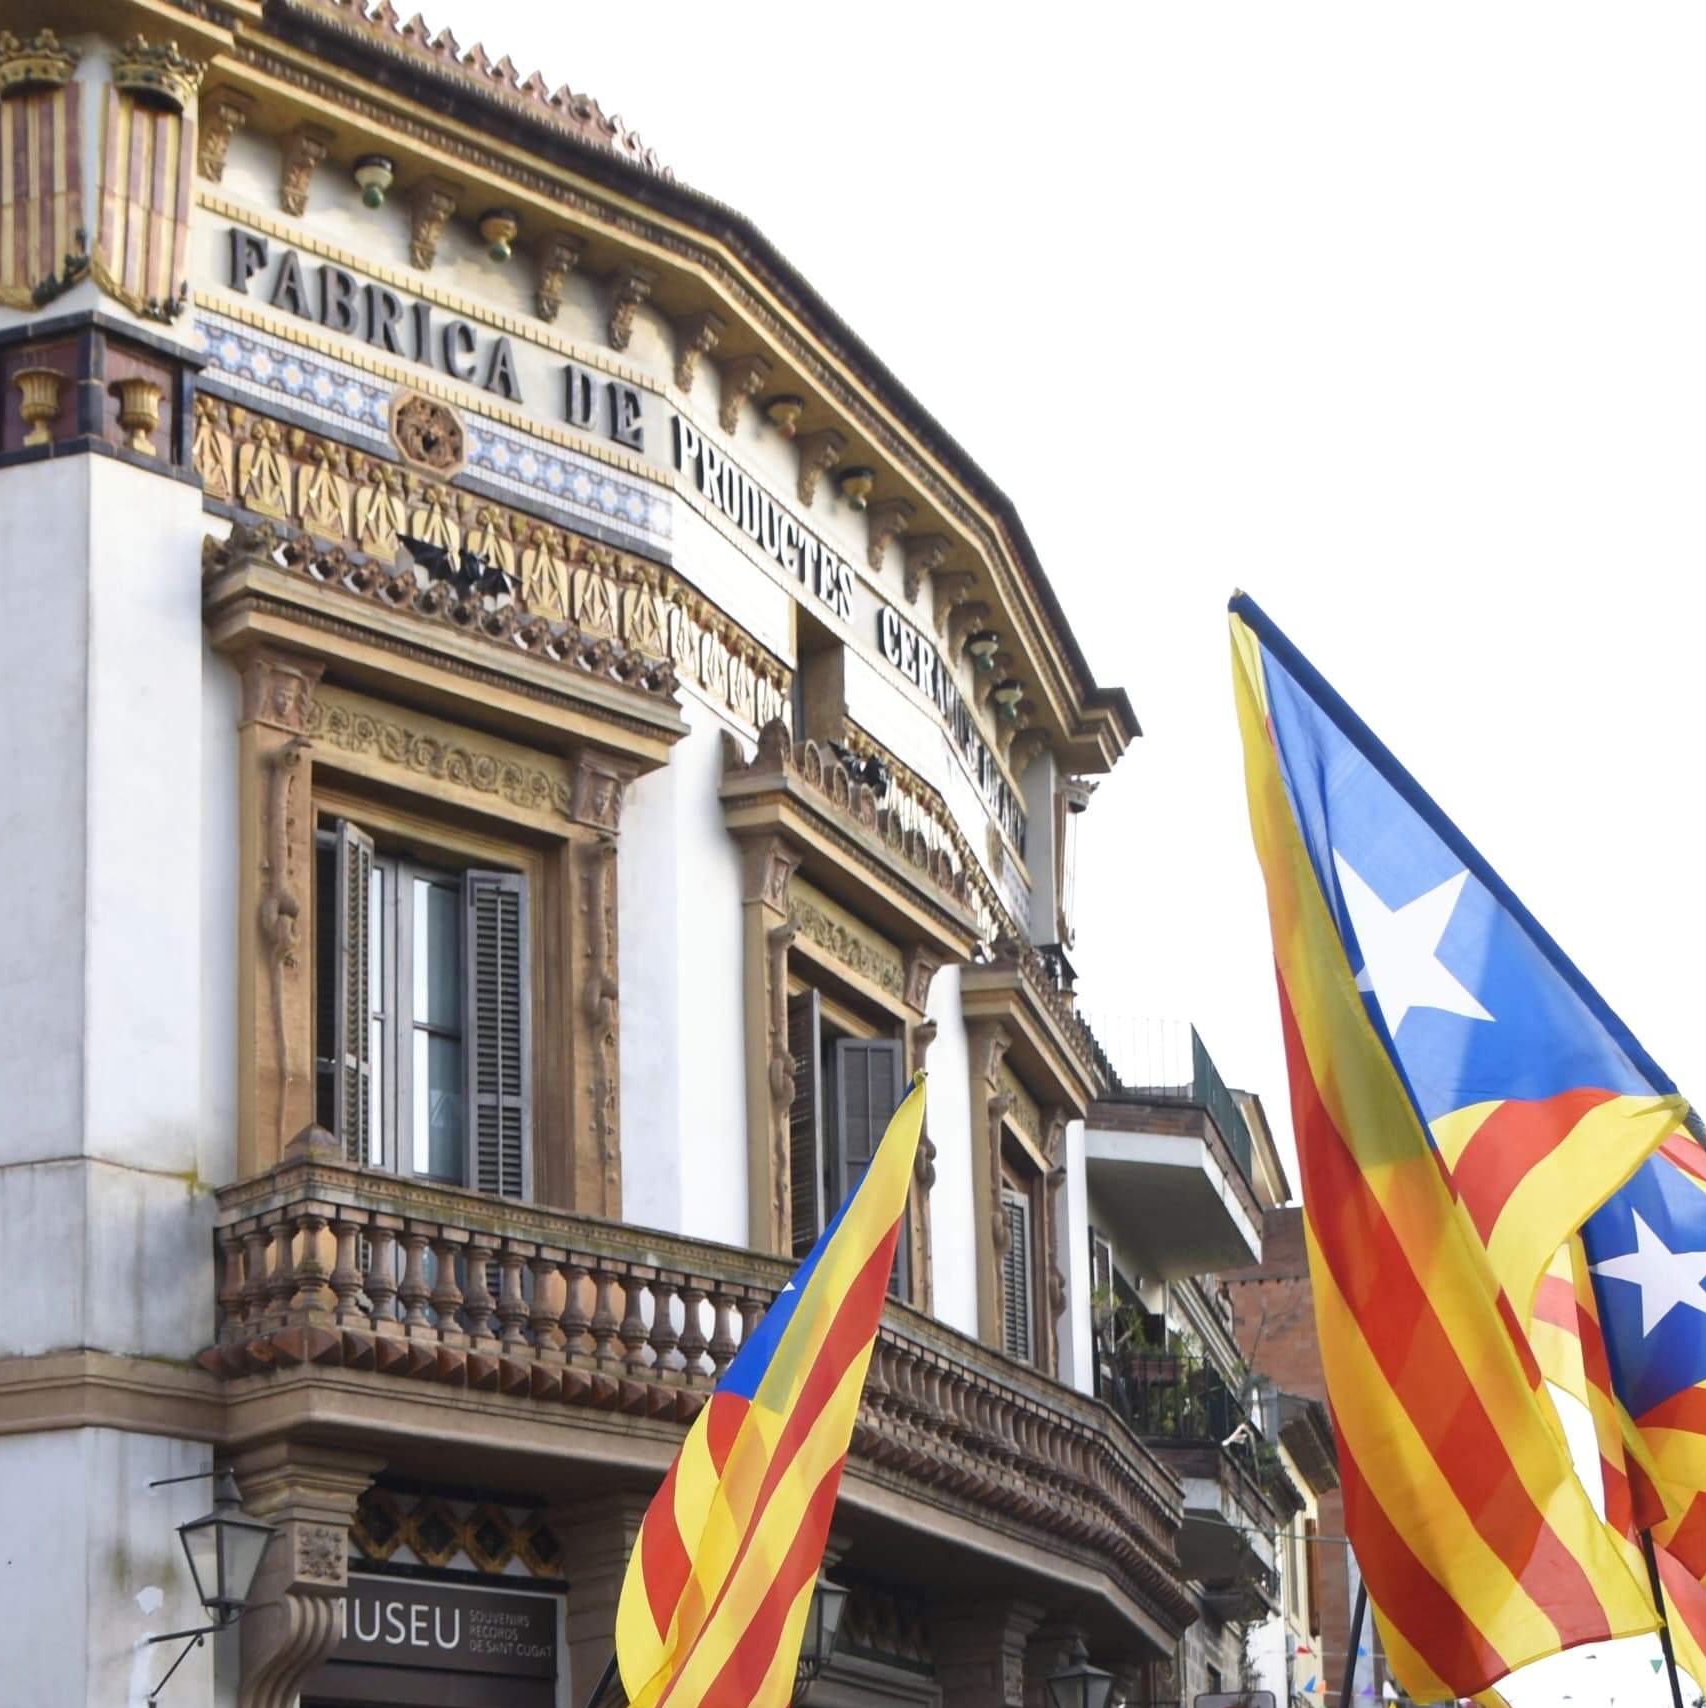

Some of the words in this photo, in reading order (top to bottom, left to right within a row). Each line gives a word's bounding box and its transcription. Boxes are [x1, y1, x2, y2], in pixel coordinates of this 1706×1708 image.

[229, 227, 524, 404] FABRICA
[564, 364, 645, 452] DE
[672, 414, 856, 625] PRODUCTES
